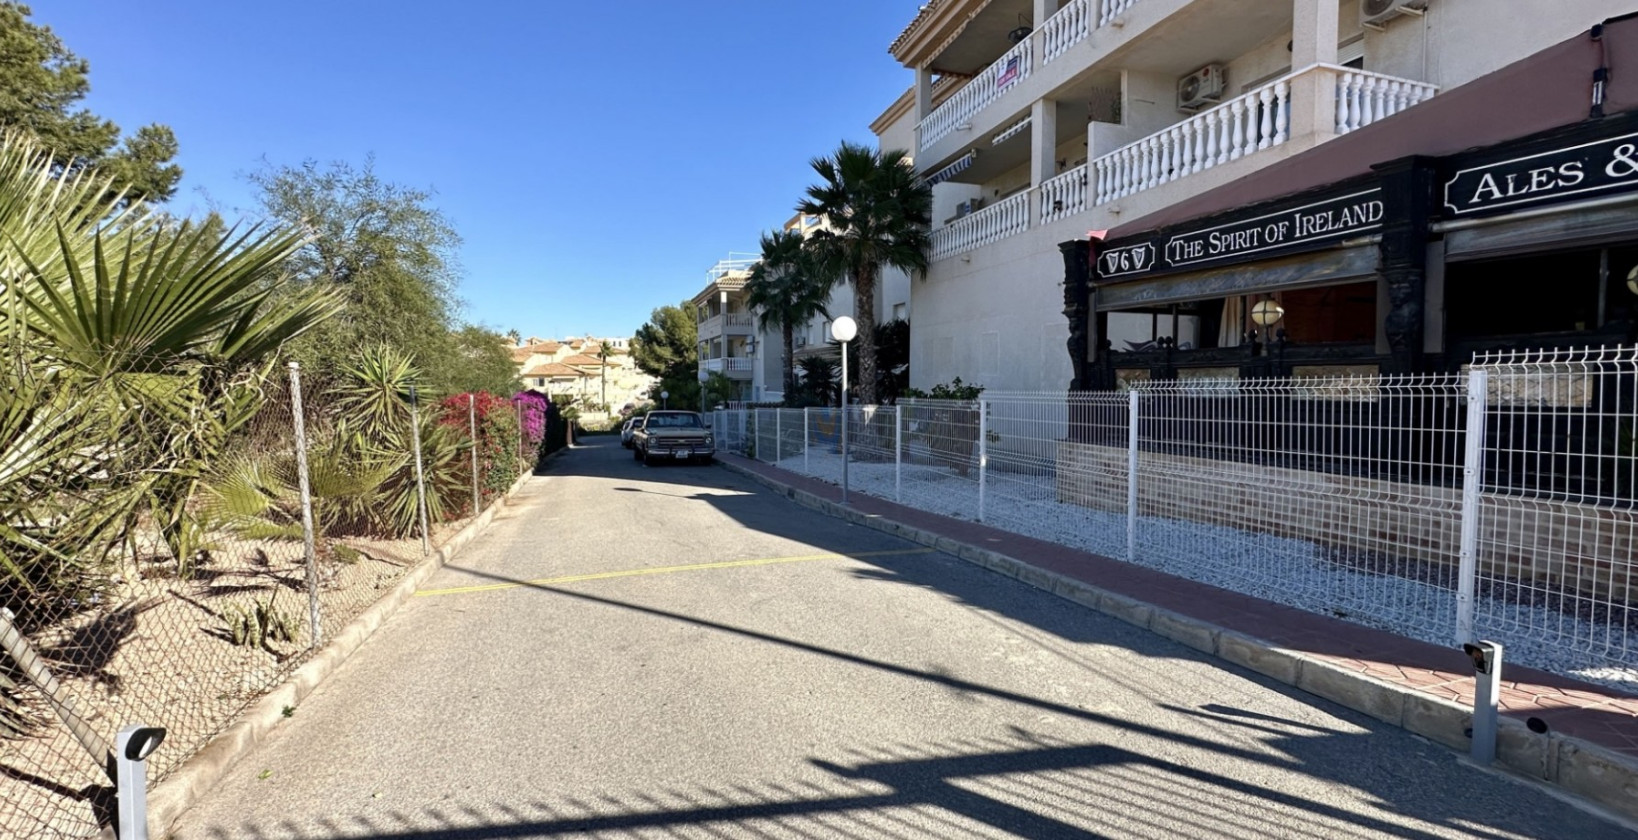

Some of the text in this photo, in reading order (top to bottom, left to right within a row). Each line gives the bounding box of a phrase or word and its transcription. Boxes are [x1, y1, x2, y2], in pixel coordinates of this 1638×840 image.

[1468, 143, 1638, 204] ALES &
[1171, 200, 1384, 260] THE SPIRIT OF IRELAND
[1121, 251, 1129, 271] 6
